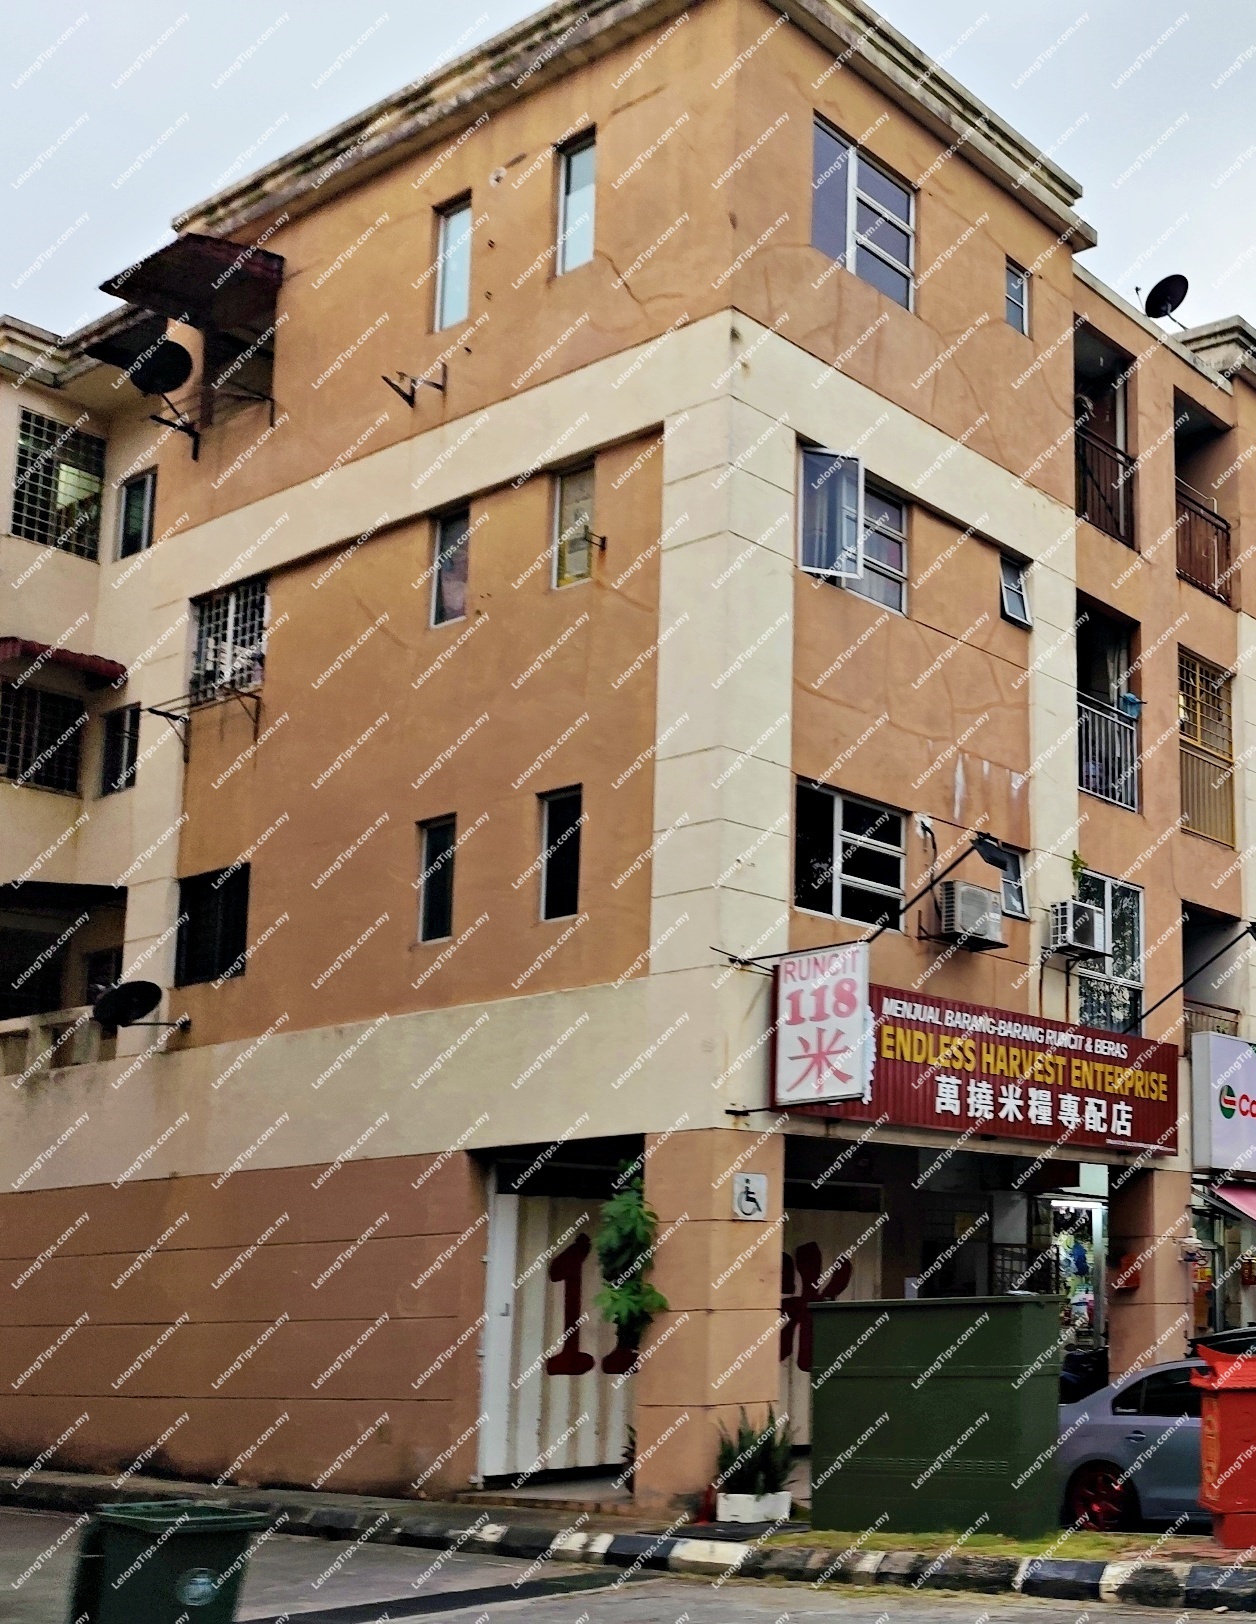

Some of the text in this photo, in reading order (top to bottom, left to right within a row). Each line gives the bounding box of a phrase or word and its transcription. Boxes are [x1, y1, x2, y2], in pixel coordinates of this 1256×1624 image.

[783, 949, 859, 984] RUNCIT
[786, 977, 857, 1026] 118
[882, 997, 1128, 1060] MENJUAL BARANG-BARANG RUNCIT & BERAS
[786, 1027, 854, 1093] 米
[880, 1025, 1168, 1102] ENDLESS HARVEST ENTERPRISE
